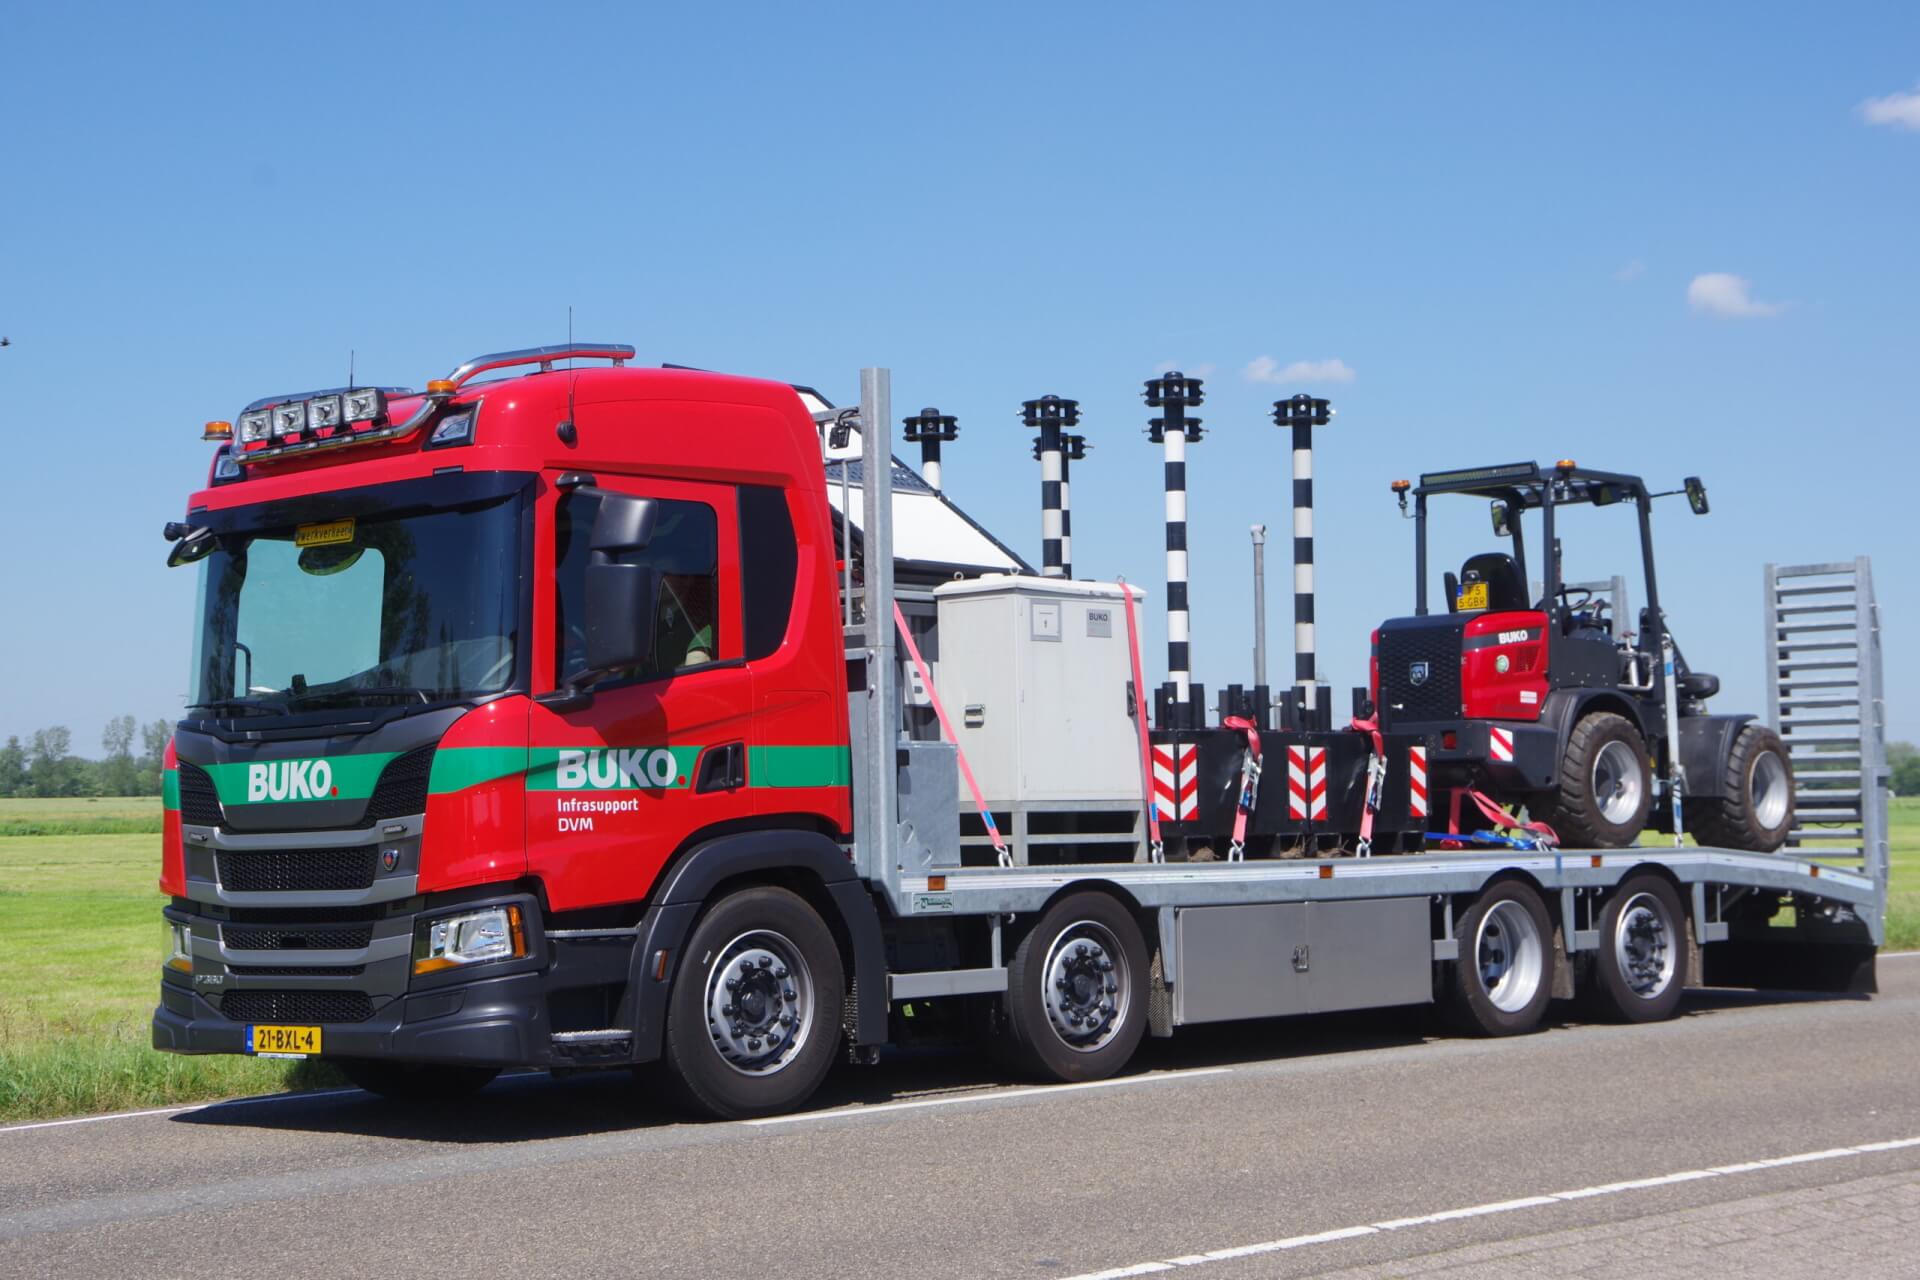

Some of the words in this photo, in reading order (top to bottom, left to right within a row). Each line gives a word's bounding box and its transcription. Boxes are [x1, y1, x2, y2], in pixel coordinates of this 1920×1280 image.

[1088, 612, 1109, 622] BUKO
[1498, 629, 1528, 644] BUKO
[557, 798, 639, 814] Infrasupport
[558, 817, 593, 832] DVM
[259, 1029, 314, 1050] 21-BXL-4
